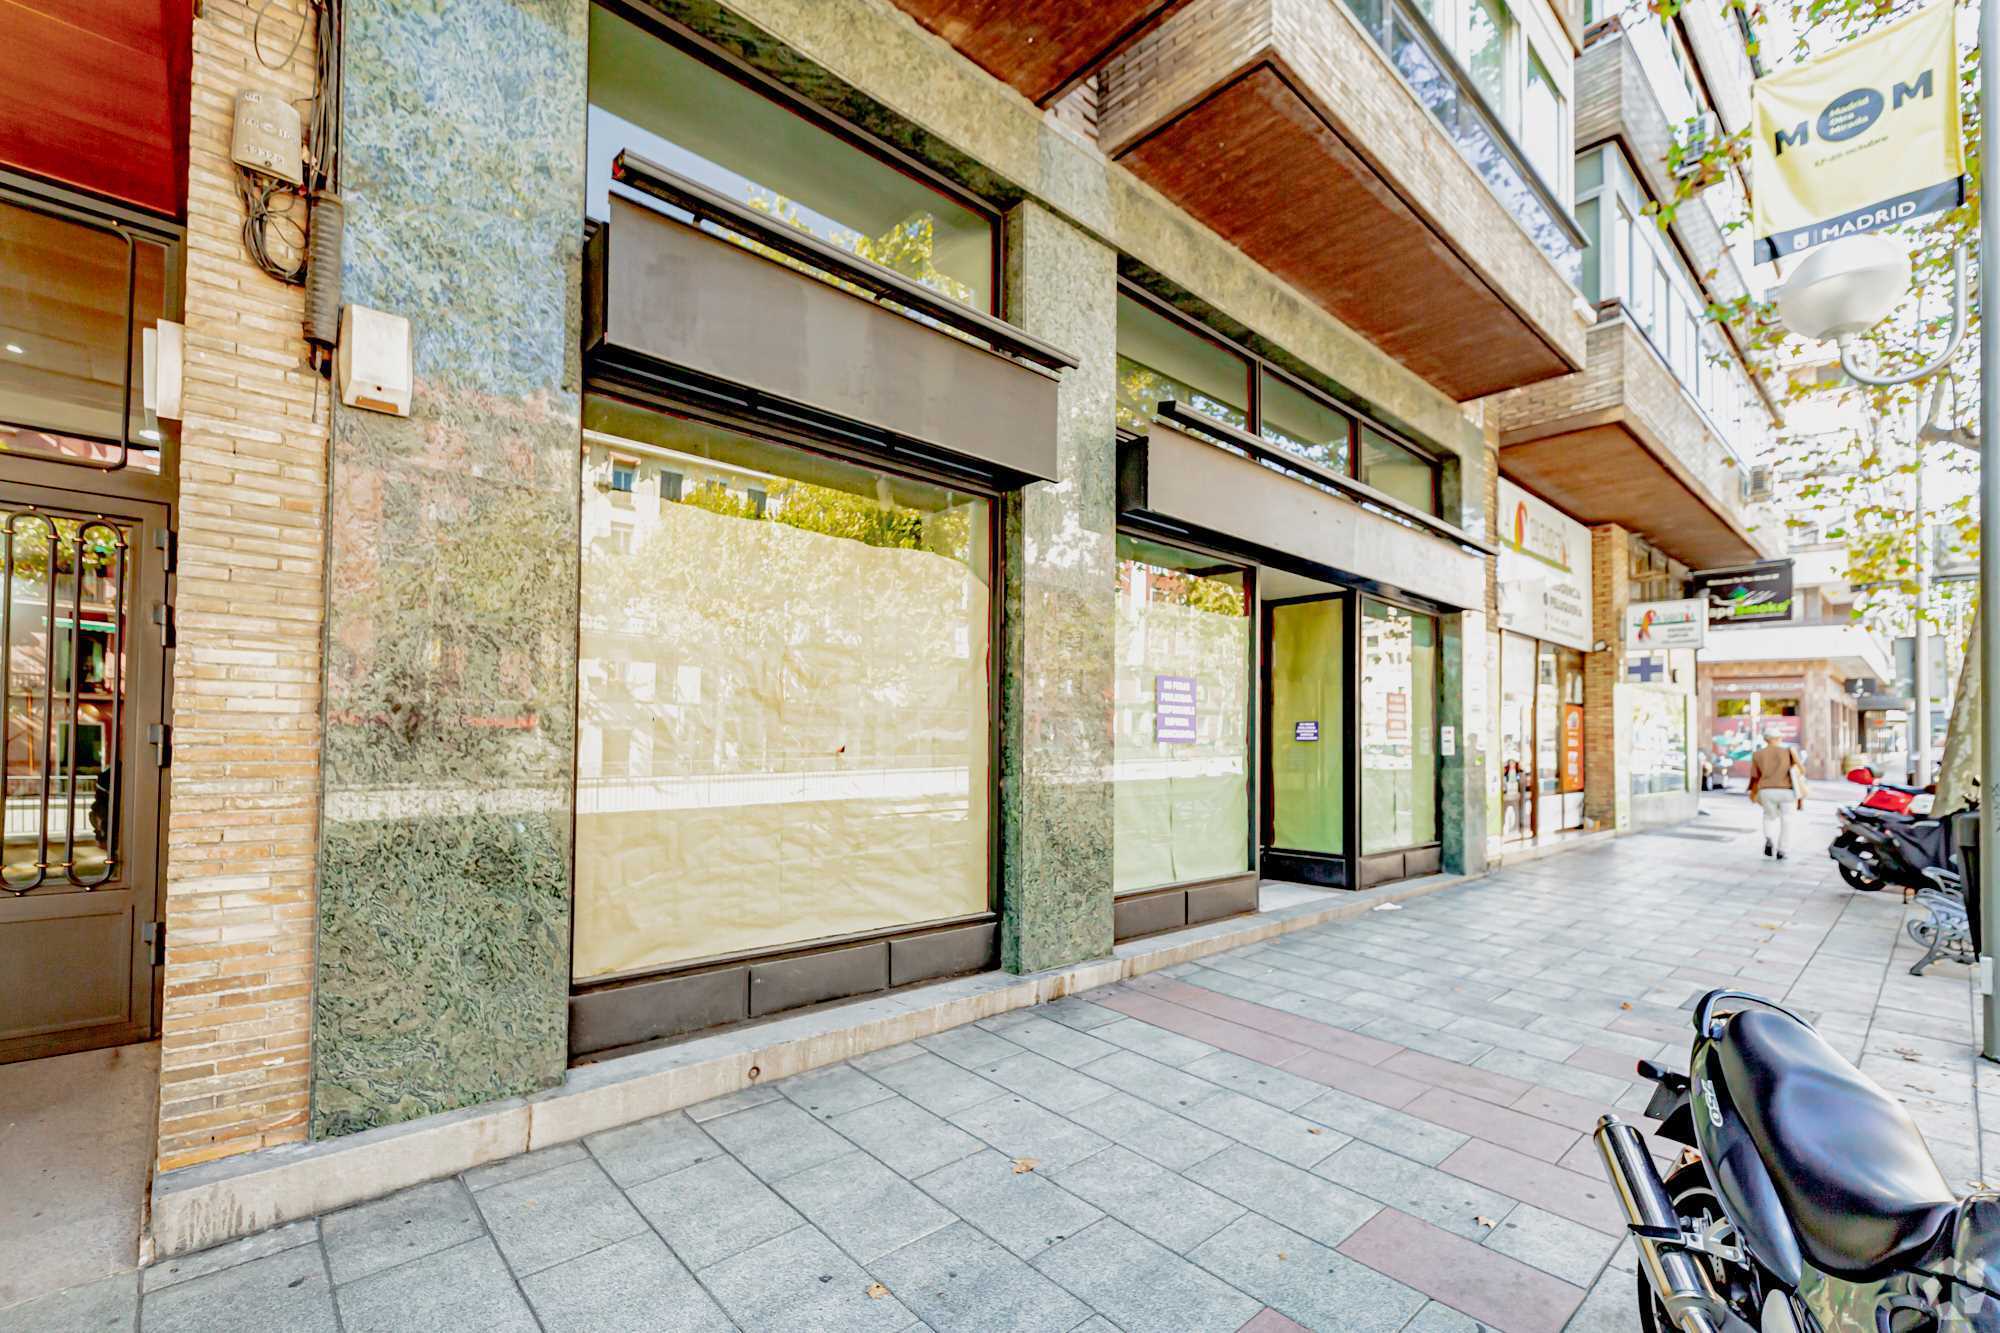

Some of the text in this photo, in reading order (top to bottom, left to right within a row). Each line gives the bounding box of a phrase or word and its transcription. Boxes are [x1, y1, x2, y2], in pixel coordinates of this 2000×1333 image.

[1828, 95, 1870, 118] Madrid
[1828, 115, 1870, 136] Mirada
[1821, 200, 1917, 242] MADRID
[1700, 1079, 1724, 1128] 750
